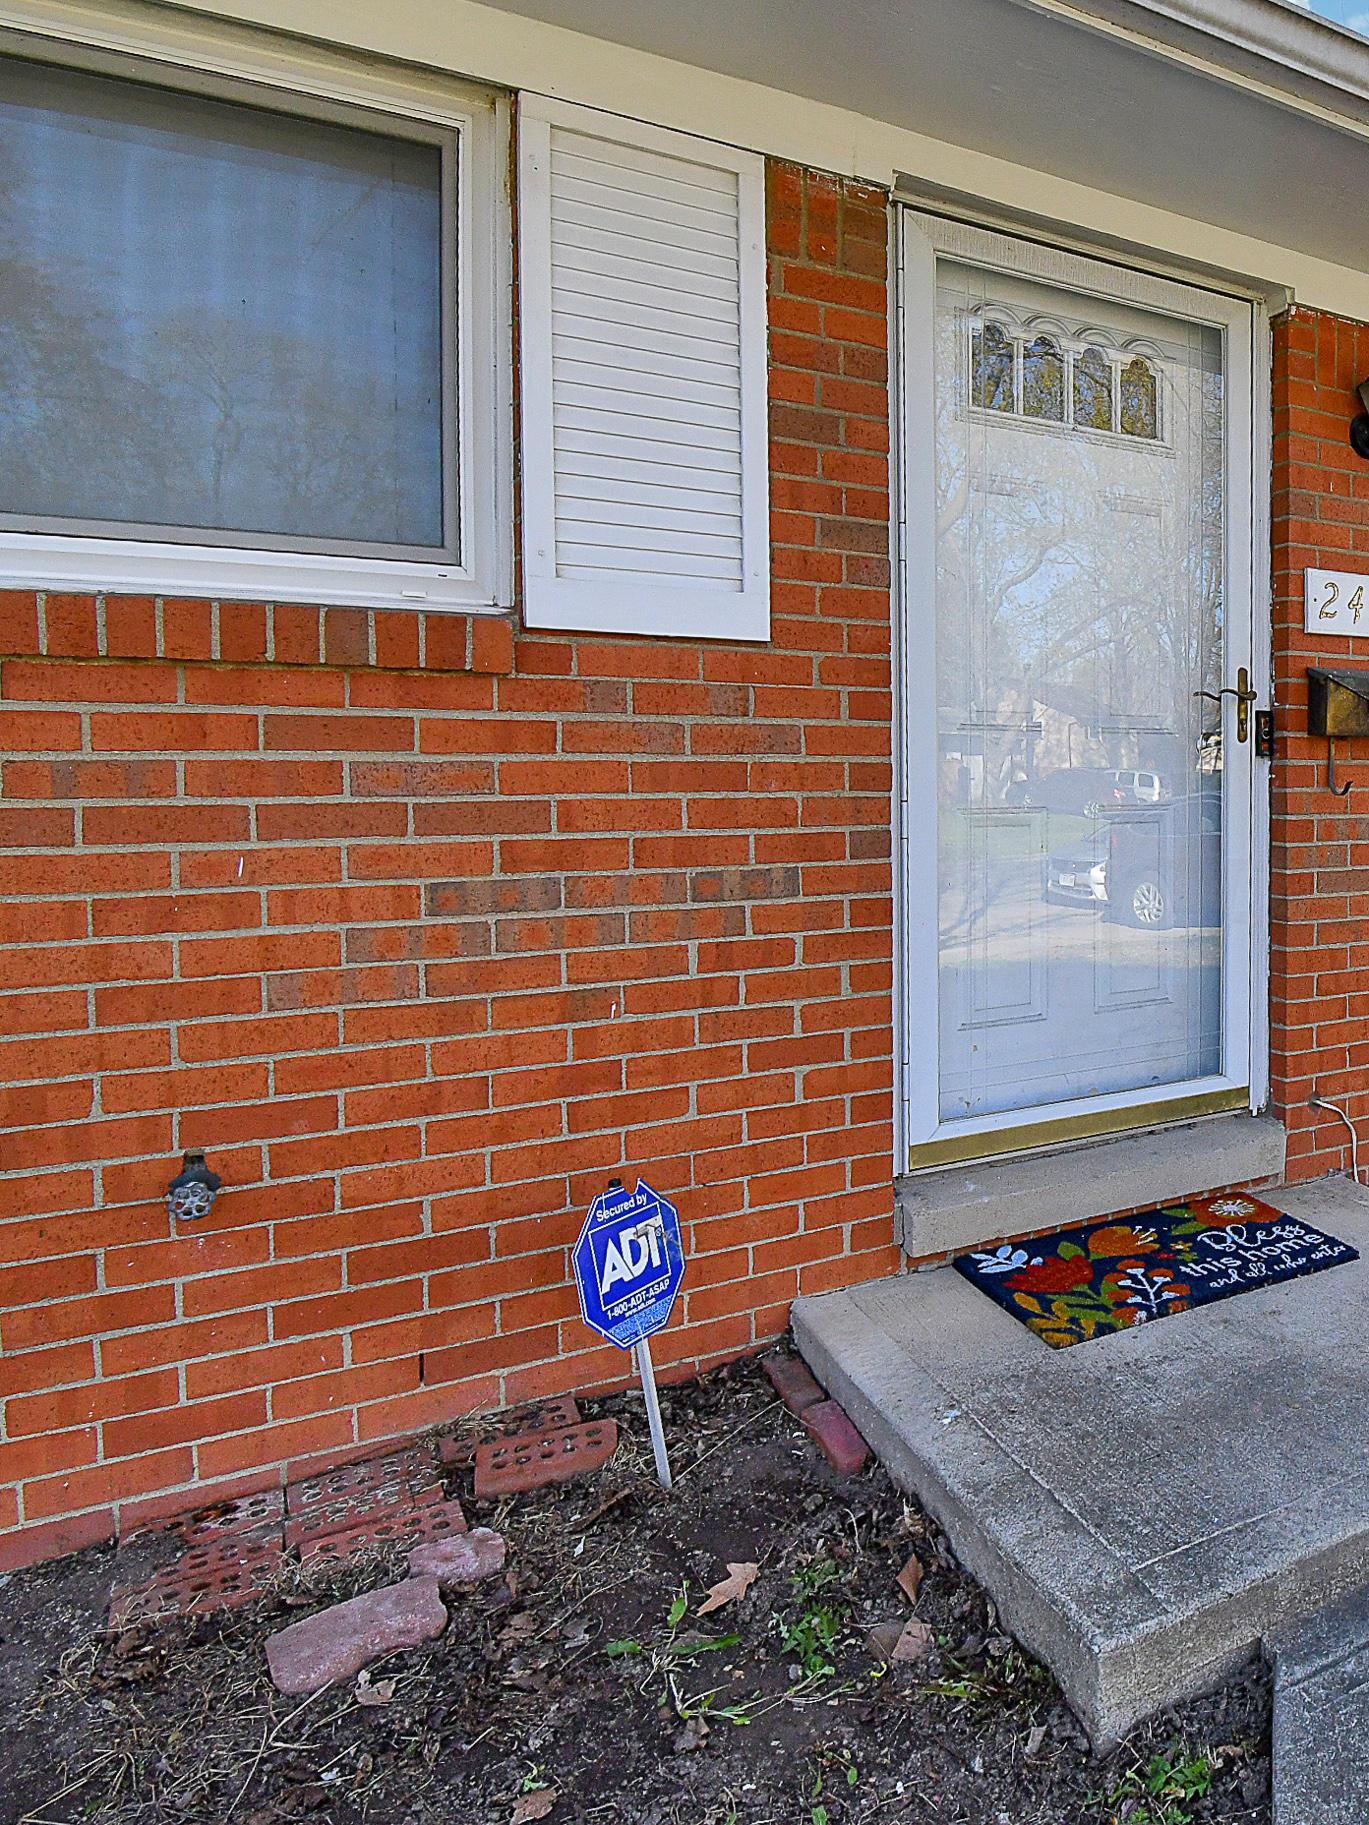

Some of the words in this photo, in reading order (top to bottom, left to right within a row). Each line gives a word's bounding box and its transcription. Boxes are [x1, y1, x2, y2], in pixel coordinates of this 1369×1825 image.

[595, 1197, 636, 1222] Secured
[635, 1192, 647, 1206] by
[600, 1213, 663, 1295] ADT
[1179, 1256, 1243, 1277] this
[1238, 1234, 1325, 1261] home
[1197, 1224, 1306, 1252] Bless
[1209, 1268, 1246, 1289] and
[1245, 1262, 1273, 1278] all
[1273, 1253, 1307, 1271] who
[607, 1278, 670, 1321] 1-800-ADT-ASAP
